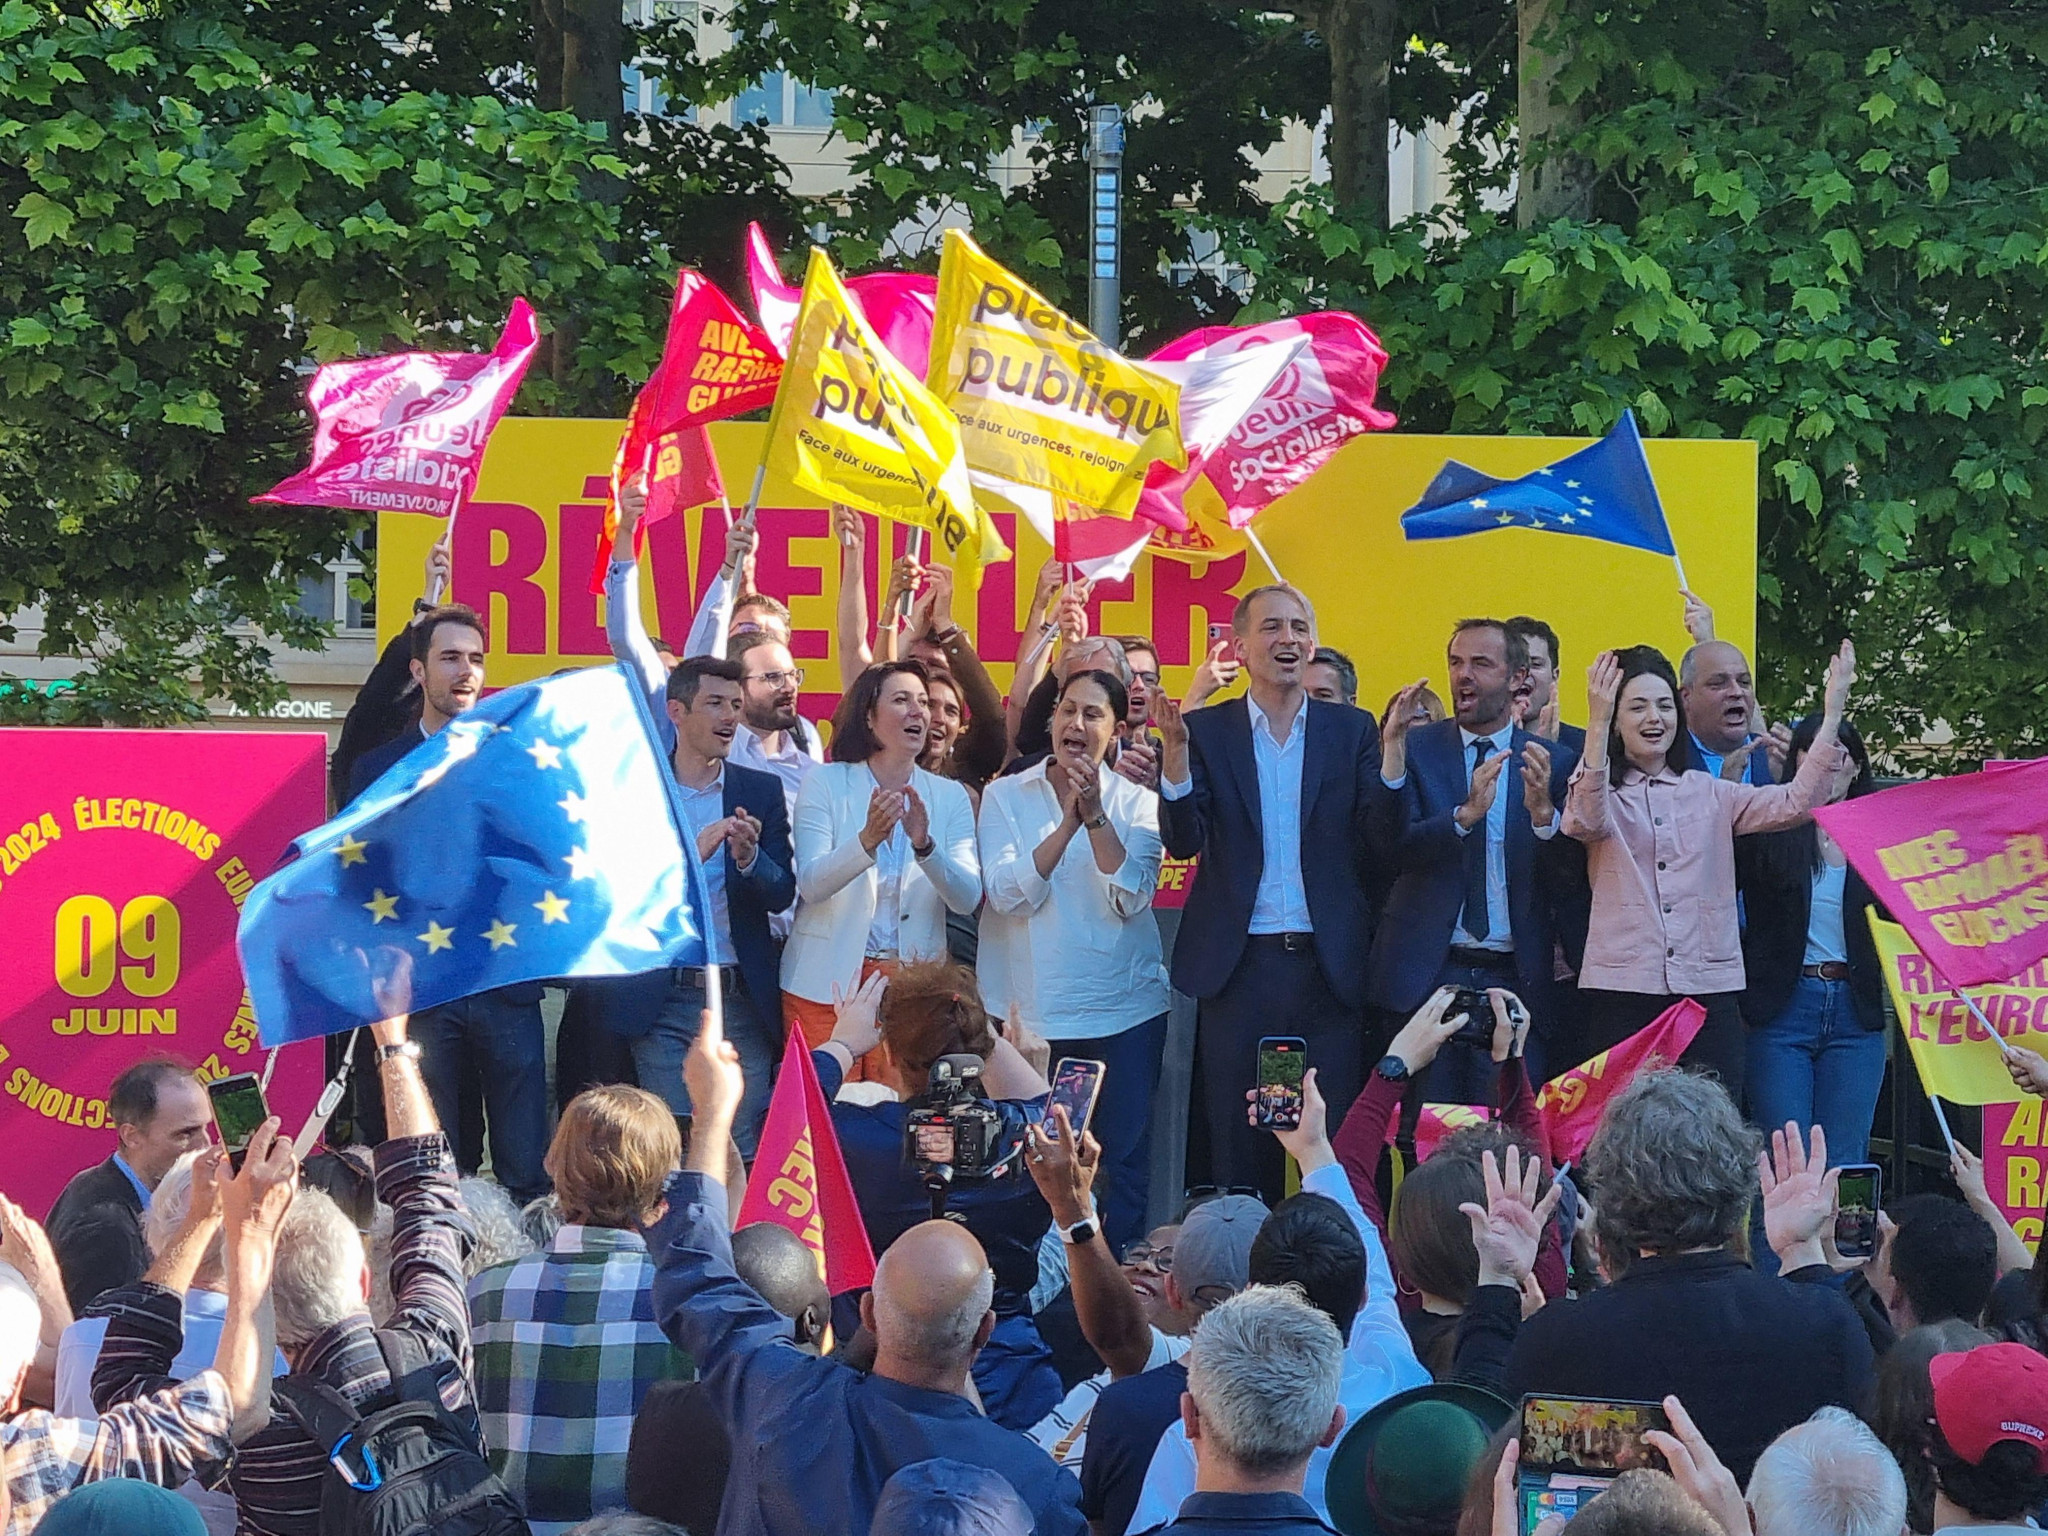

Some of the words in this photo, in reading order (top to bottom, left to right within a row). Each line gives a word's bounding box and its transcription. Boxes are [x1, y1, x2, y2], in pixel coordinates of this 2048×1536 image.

[798, 428, 831, 454] Face
[832, 447, 860, 468] aux
[862, 460, 921, 488] urgence
[950, 409, 975, 427] ace
[977, 416, 1003, 434] aux
[1006, 424, 1076, 458] urgences,
[1079, 449, 1128, 473] rejoign
[0, 812, 61, 876] 2024
[73, 796, 221, 861] ÉLECTIONS
[1929, 881, 2048, 947] GLUCKS
[55, 894, 181, 998] 09
[52, 1008, 177, 1035] JUIN
[1909, 995, 2048, 1044] L'EURO
[5, 1067, 116, 1129] CTIONS
[192, 1053, 230, 1085] 20
